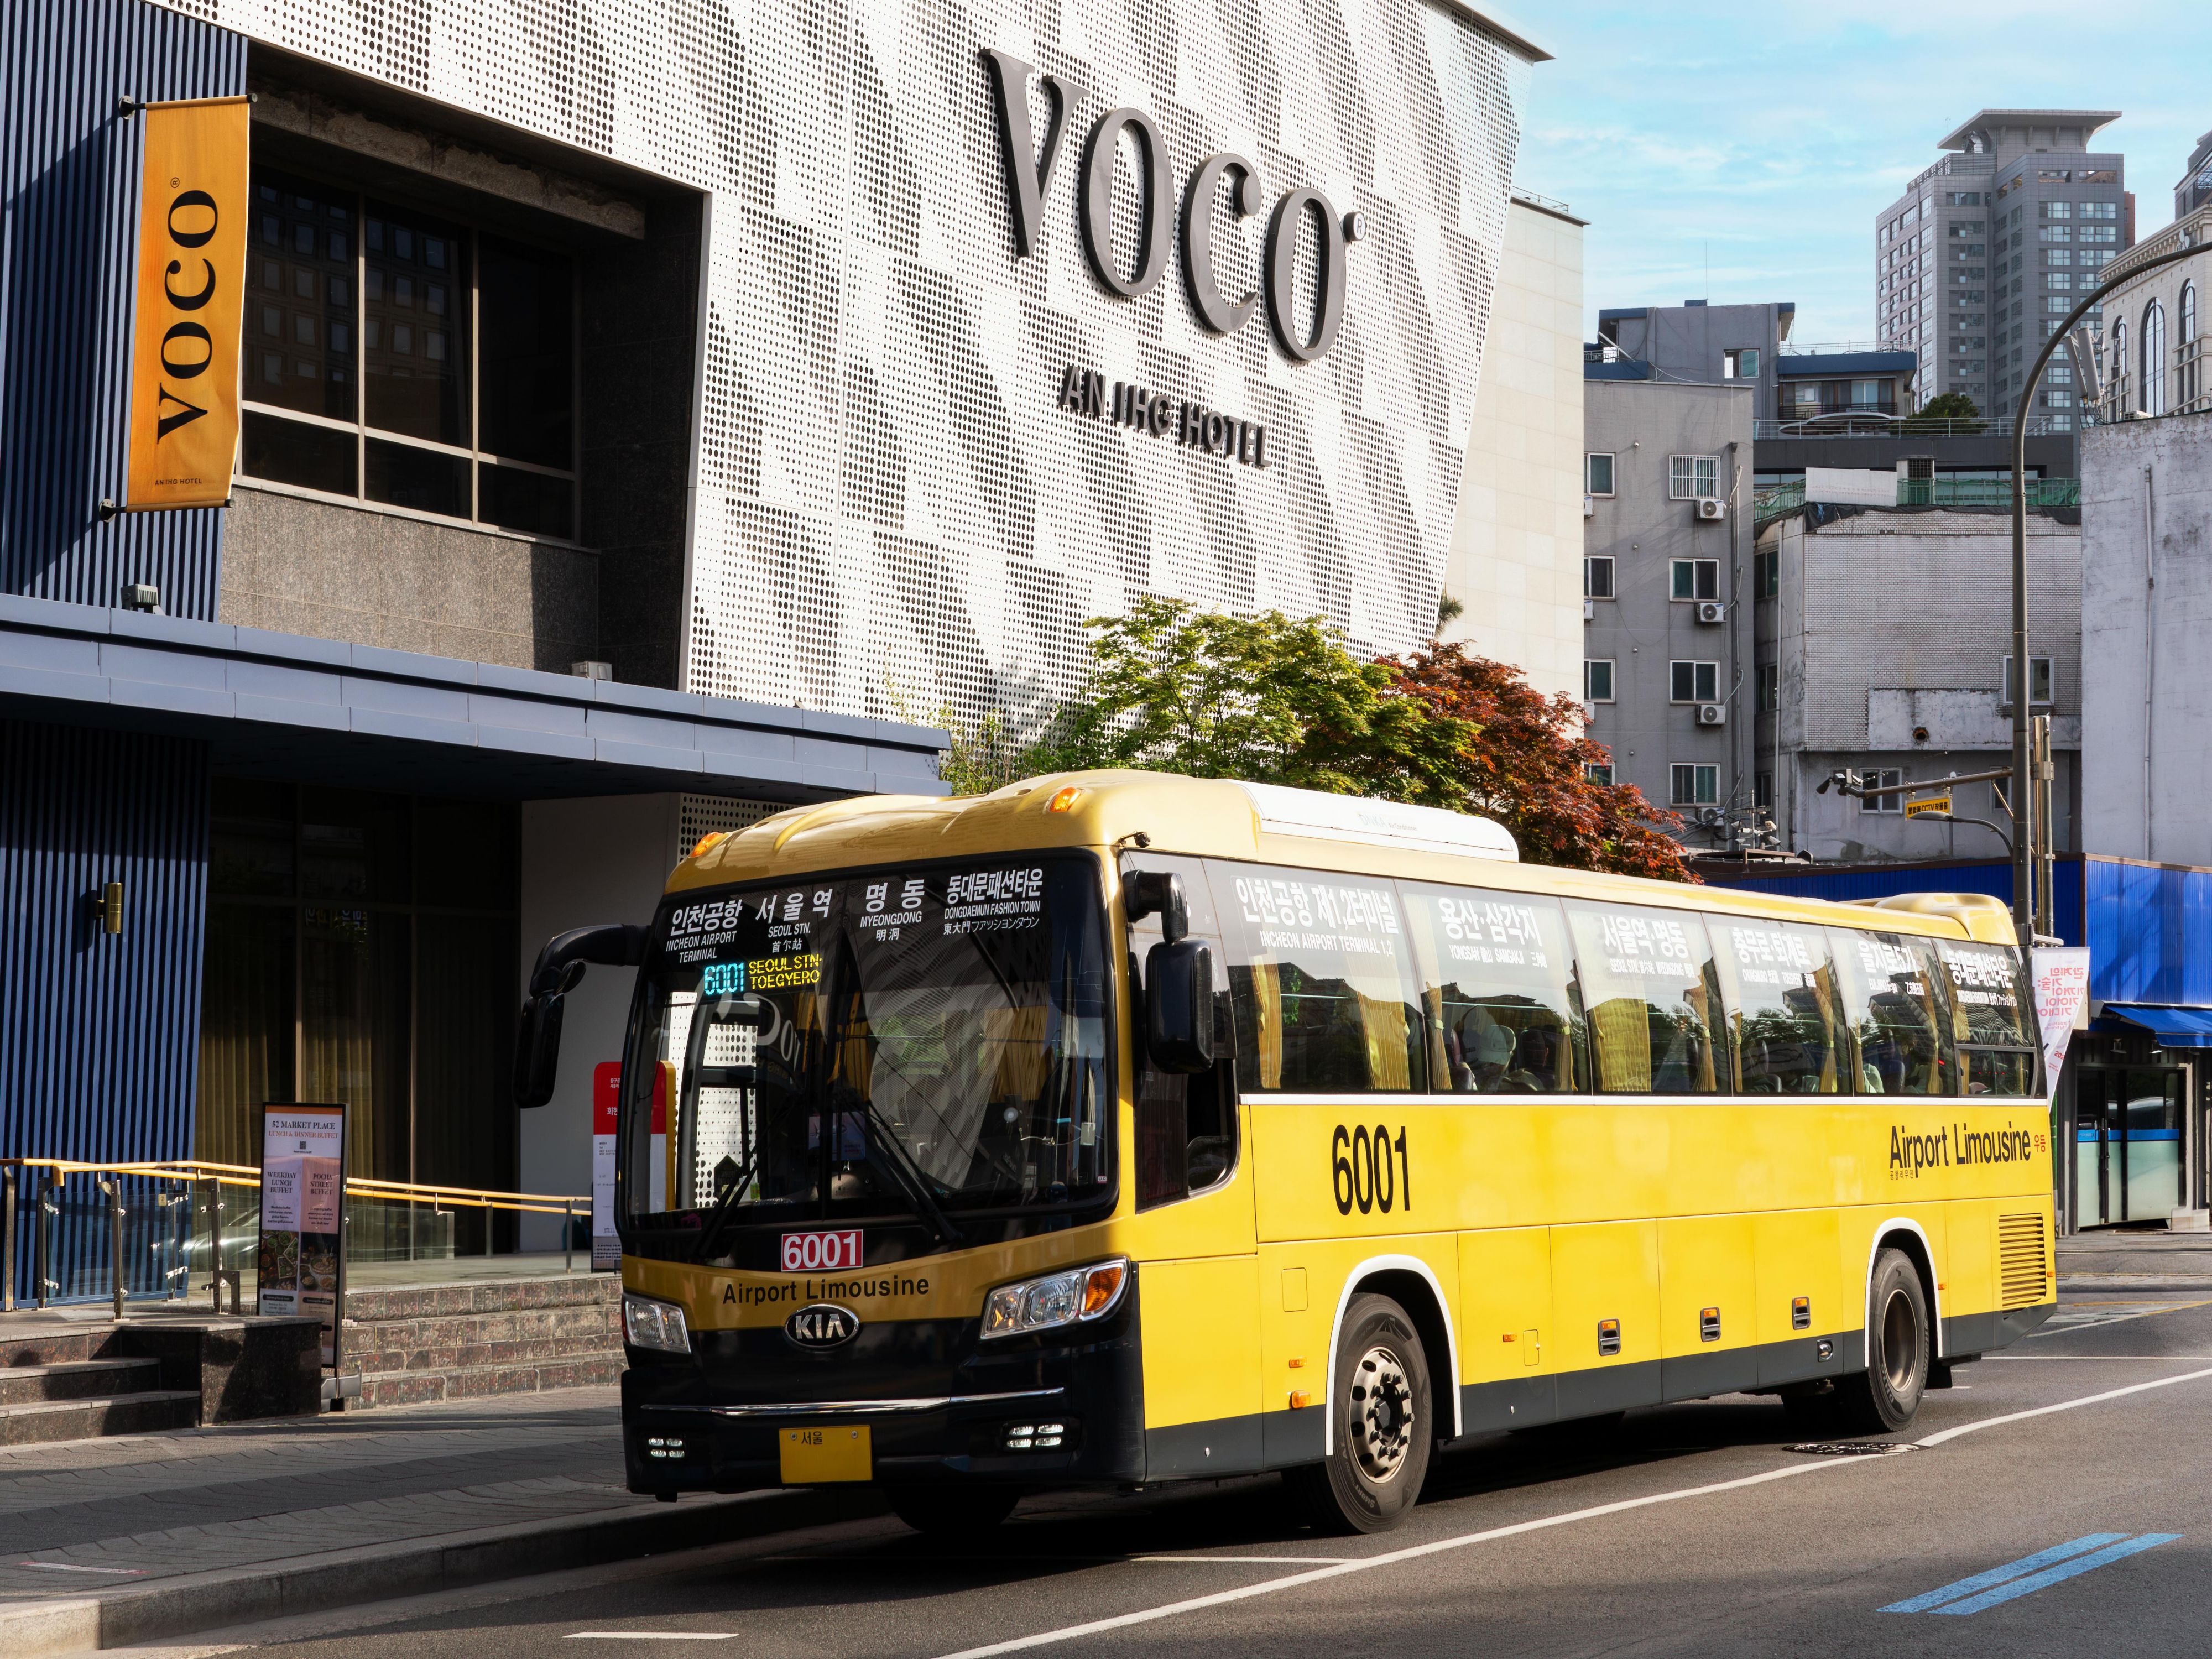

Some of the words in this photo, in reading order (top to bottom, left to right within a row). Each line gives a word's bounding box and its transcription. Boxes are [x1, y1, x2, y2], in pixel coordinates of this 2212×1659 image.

[1060, 366, 1105, 416] AN
[1113, 382, 1173, 435] IHG
[1180, 402, 1271, 467] HOTEL
[947, 868, 1043, 904] 동대문패션타운
[670, 899, 743, 936] 인천공항
[944, 904, 989, 920] DONGDAEMUN
[990, 902, 1019, 915] FASHION
[1020, 900, 1040, 912] TOWN
[1235, 878, 1313, 928] 인천공항
[1310, 884, 1399, 935] 제1,2터미널
[768, 924, 792, 938] SEOUL
[794, 922, 811, 935] STN.
[860, 911, 922, 928] MYEONGDONG
[666, 935, 700, 952] INCHEON
[701, 931, 737, 945] AIRPORT
[1260, 930, 1301, 949] INCHEON
[1302, 934, 1339, 951] AIRPORT
[1338, 936, 1380, 954] TERMINAL
[1449, 944, 1480, 961] YONGSAN
[679, 947, 717, 963] TERMINAL
[748, 957, 792, 974] SEOUL
[704, 962, 744, 995] 6001
[749, 969, 820, 990] TOEGYERO
[280, 1121, 312, 1129] MARKET
[1890, 1125, 1949, 1178] Airport
[1954, 1121, 2031, 1165] Limousine
[1332, 1124, 1410, 1216] 6001
[784, 1232, 857, 1269] 6001
[722, 1281, 797, 1306] Airport
[806, 1275, 930, 1300] Limousine
[795, 1313, 847, 1340] KIA
[801, 1431, 823, 1446] 서울
